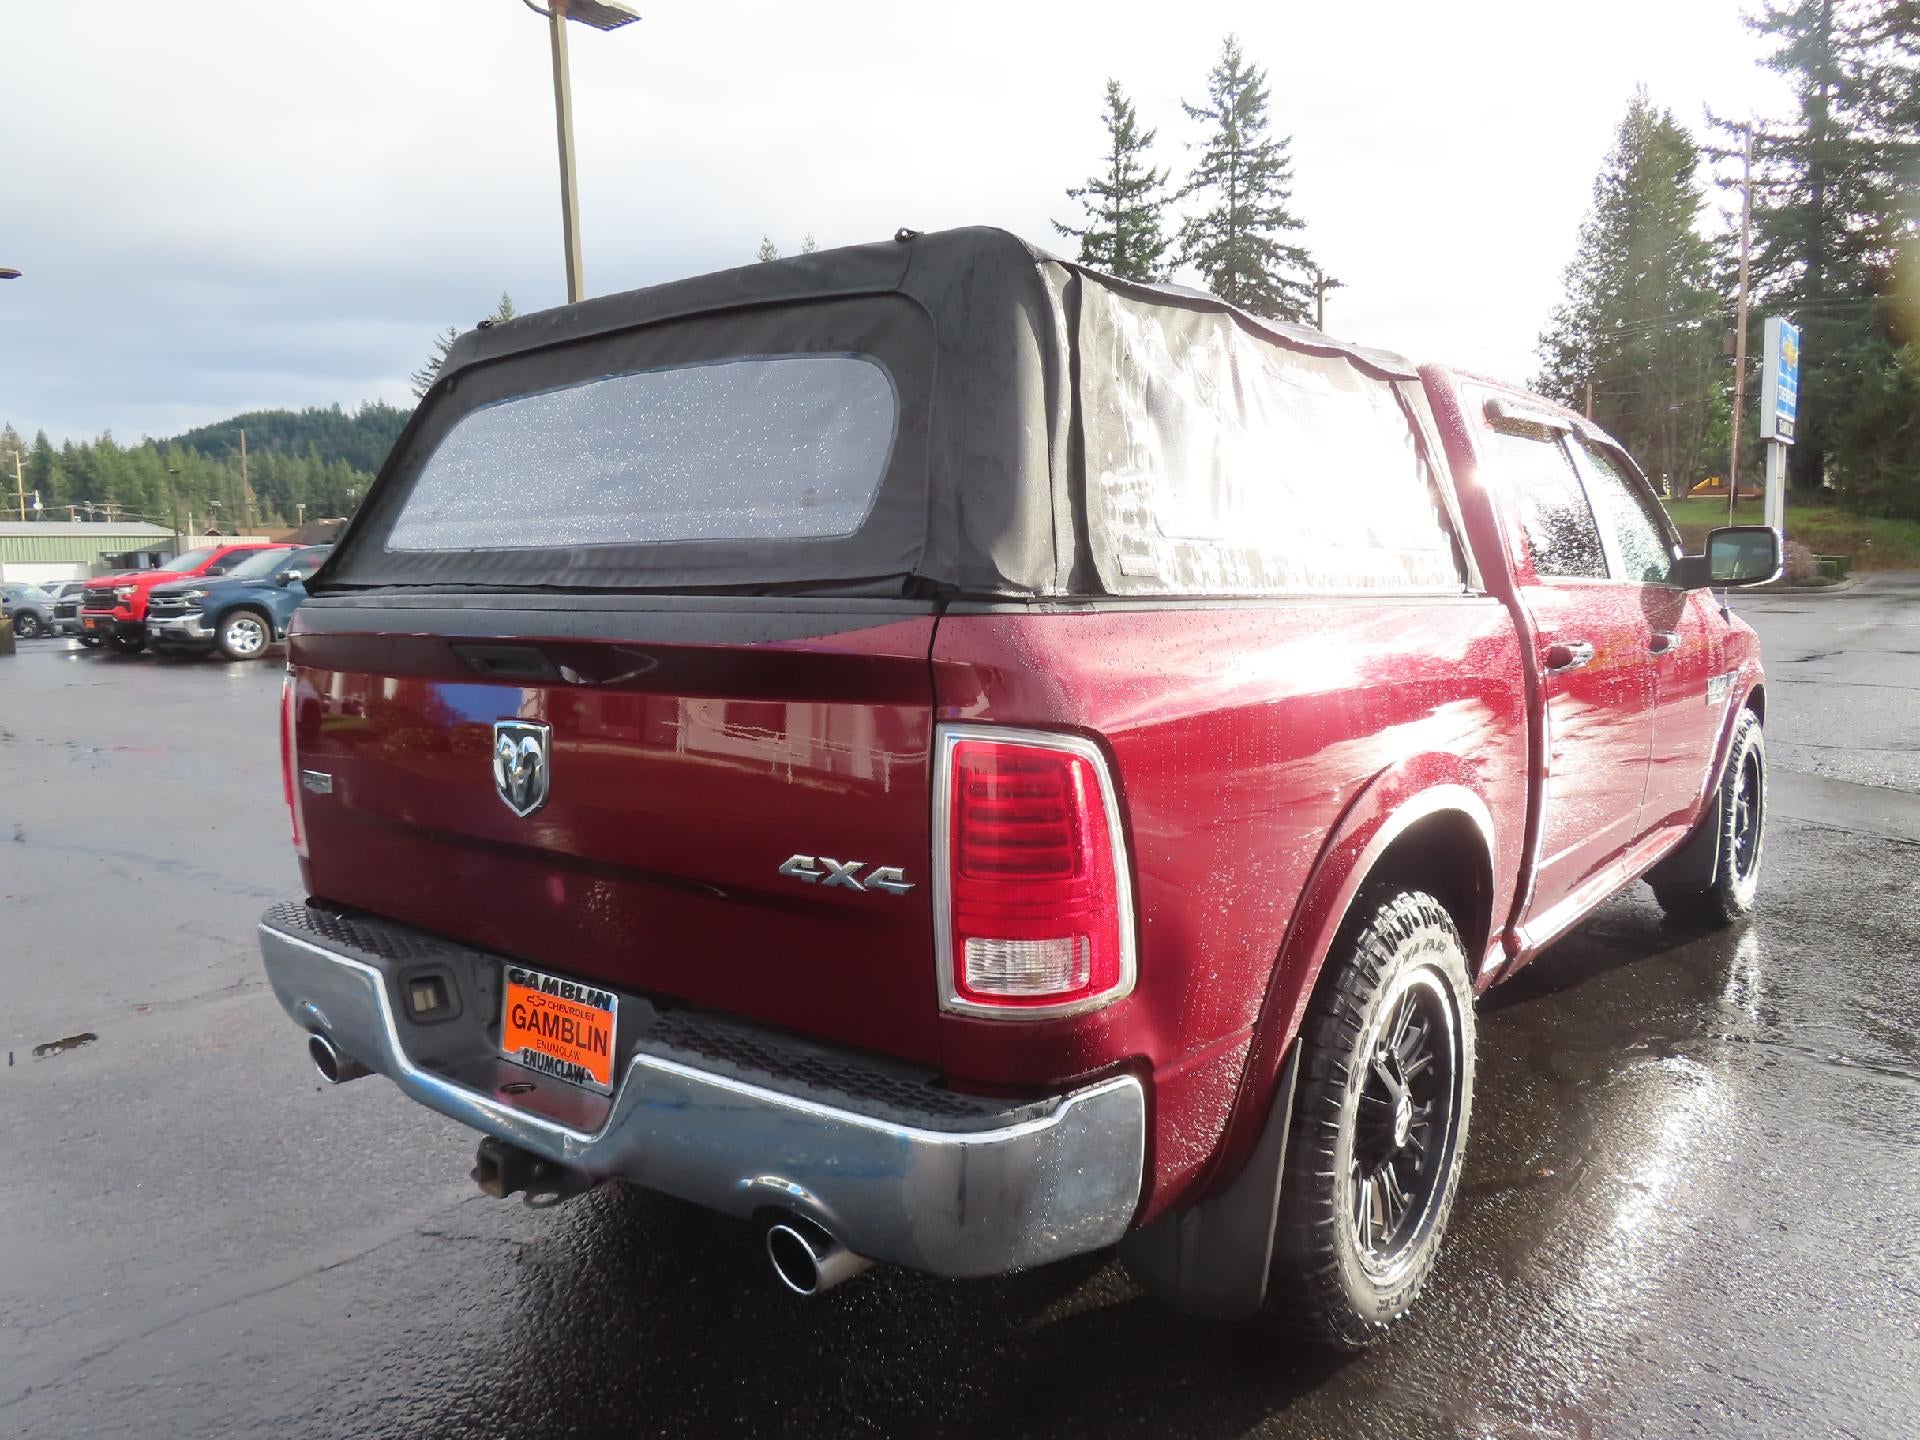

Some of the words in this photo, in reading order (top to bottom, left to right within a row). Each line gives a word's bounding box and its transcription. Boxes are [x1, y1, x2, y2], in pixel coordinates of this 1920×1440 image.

[779, 854, 916, 895] 4X4
[508, 968, 612, 1011] GAMBLIN
[511, 1003, 607, 1057] GAMBLIN
[547, 1001, 595, 1021] CHEVROLET
[523, 1048, 586, 1084] ENUMCLAW
[536, 1039, 581, 1060] ENUMCLAW
